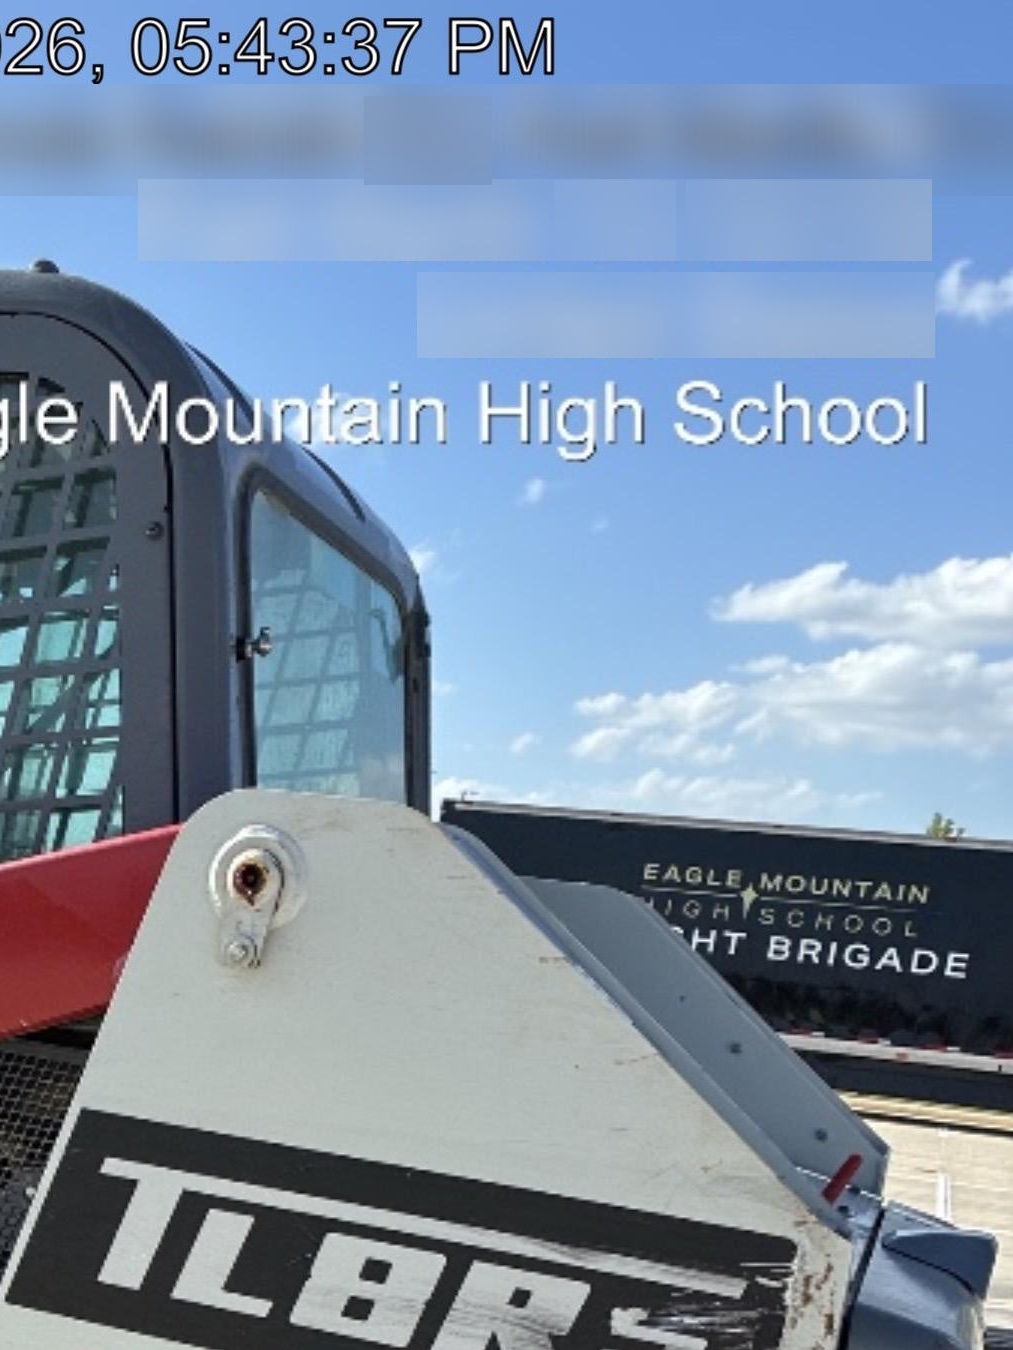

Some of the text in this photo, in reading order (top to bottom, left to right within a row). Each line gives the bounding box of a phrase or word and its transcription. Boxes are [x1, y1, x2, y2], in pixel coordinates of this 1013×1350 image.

[643, 863, 931, 904] EAGLE MOUNTAIN
[757, 908, 919, 938] SCHOOL
[766, 935, 971, 978] BRIGADE
